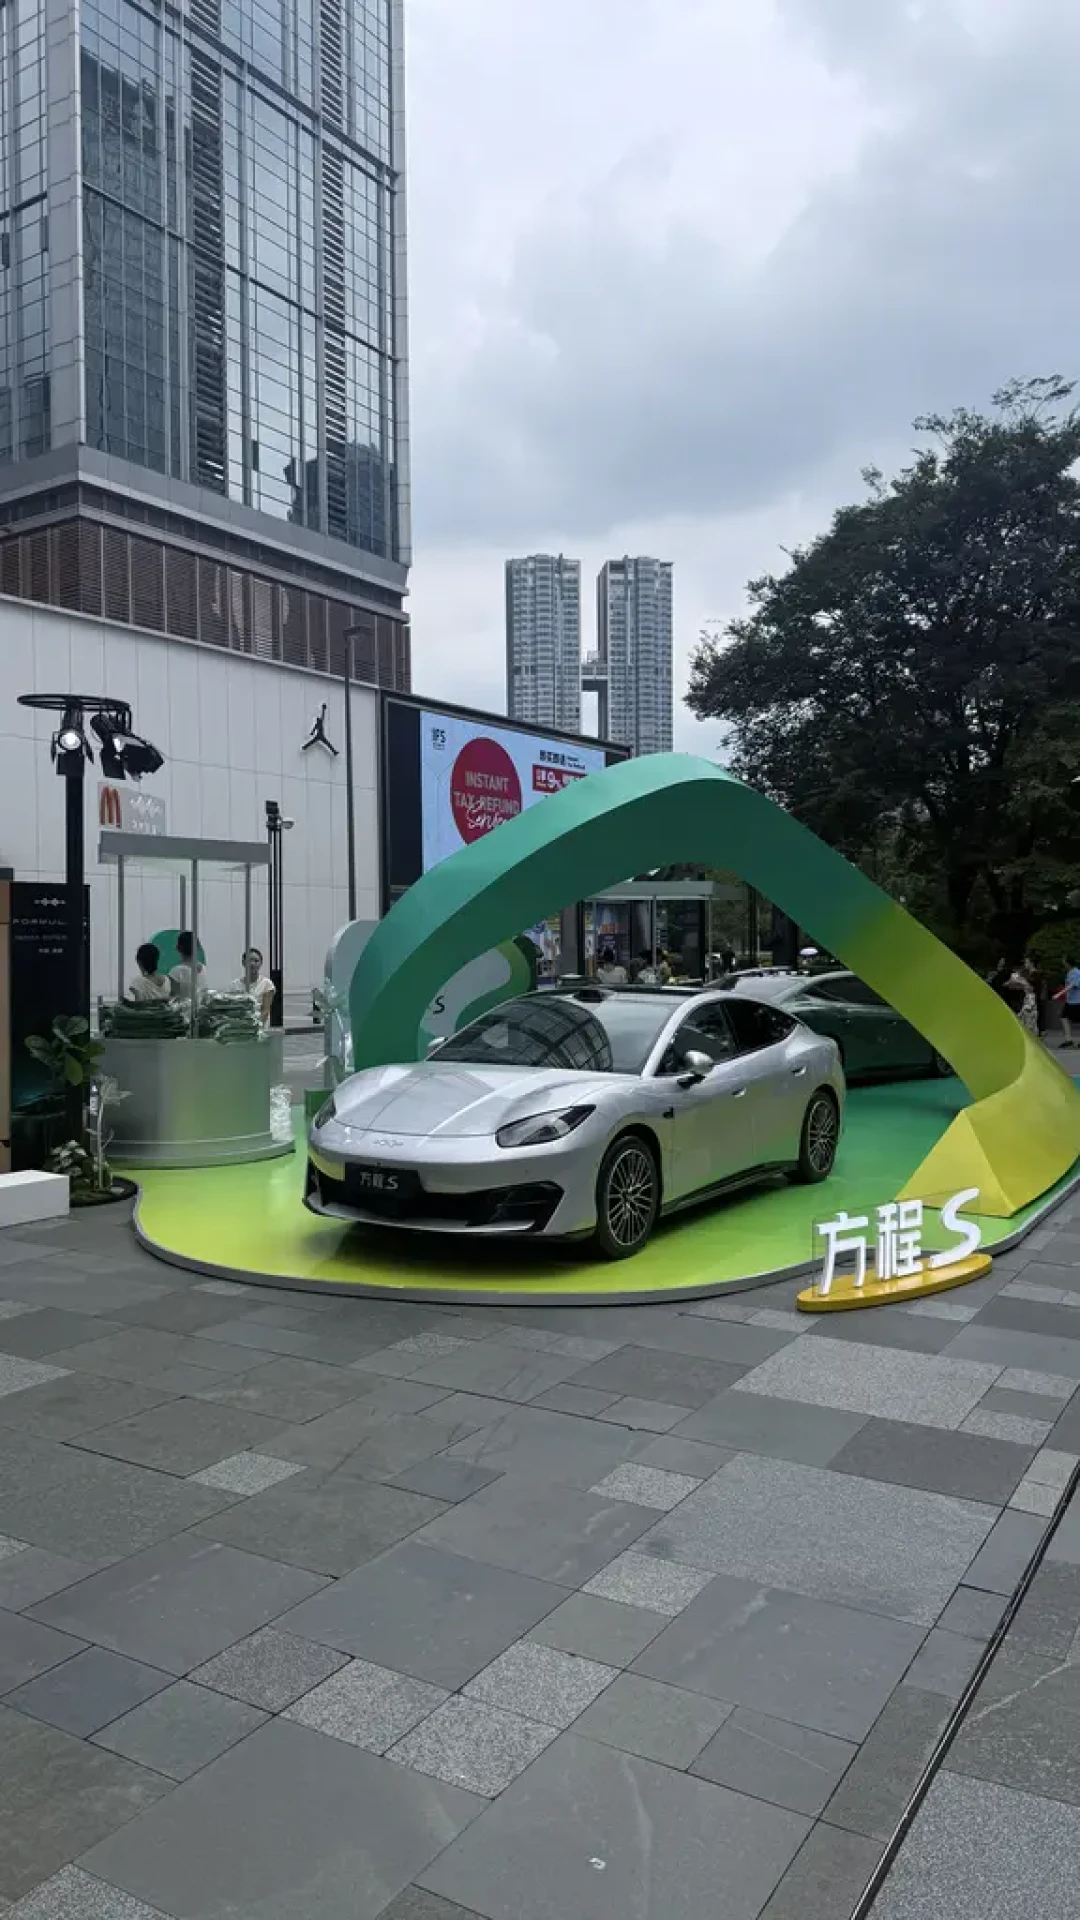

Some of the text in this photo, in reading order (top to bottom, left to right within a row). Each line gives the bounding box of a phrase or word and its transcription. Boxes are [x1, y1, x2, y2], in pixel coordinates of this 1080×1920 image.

[465, 770, 510, 792] INSTANT
[453, 791, 520, 815] TAX REFUND
[12, 917, 68, 926] FORMUL
